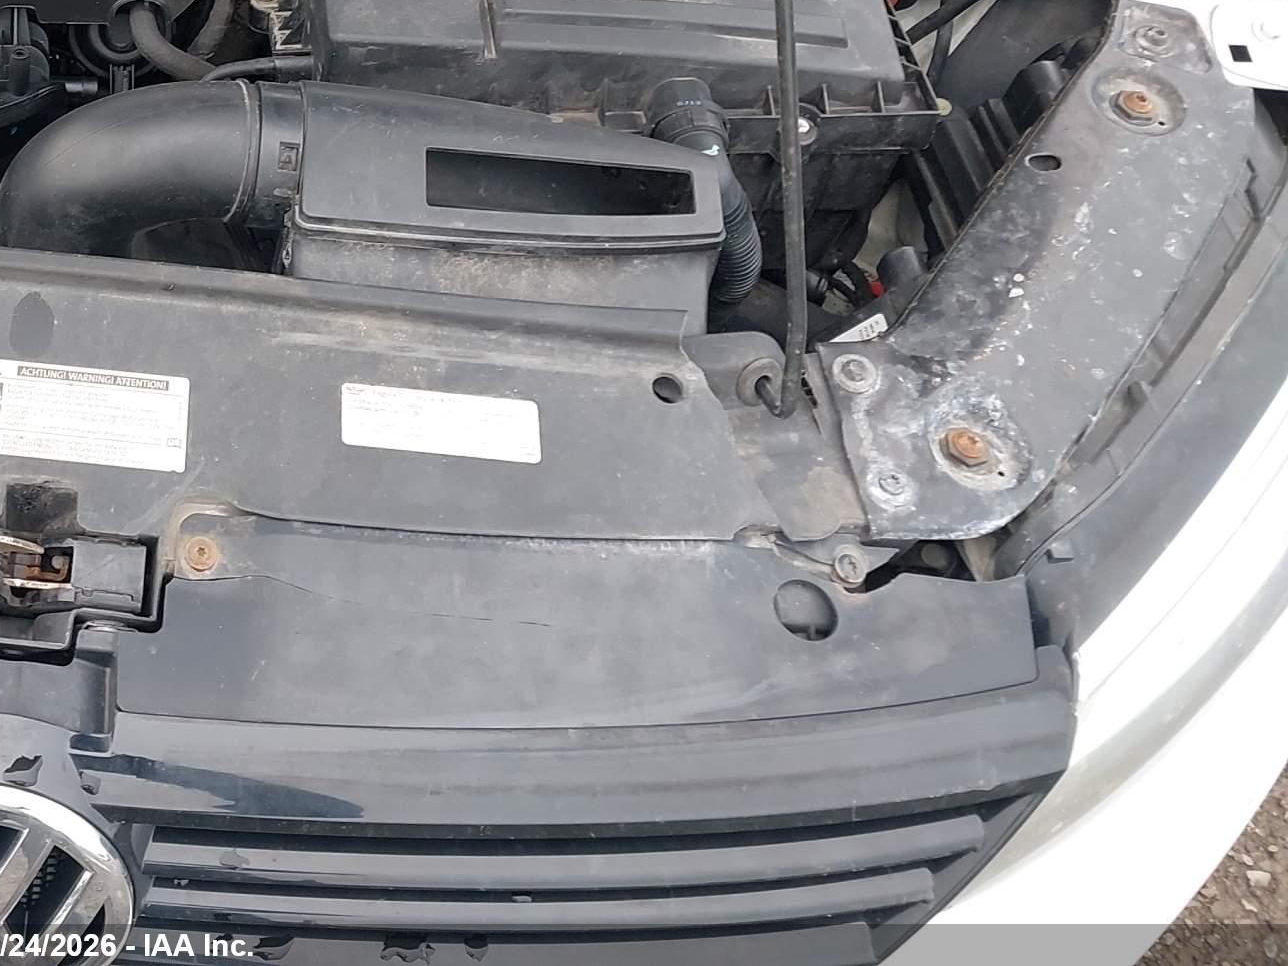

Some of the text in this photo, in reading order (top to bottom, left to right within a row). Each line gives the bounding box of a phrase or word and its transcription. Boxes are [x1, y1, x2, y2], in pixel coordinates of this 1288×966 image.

[19, 366, 169, 390] ACHTUNG! WARNING! ATTENTION!
